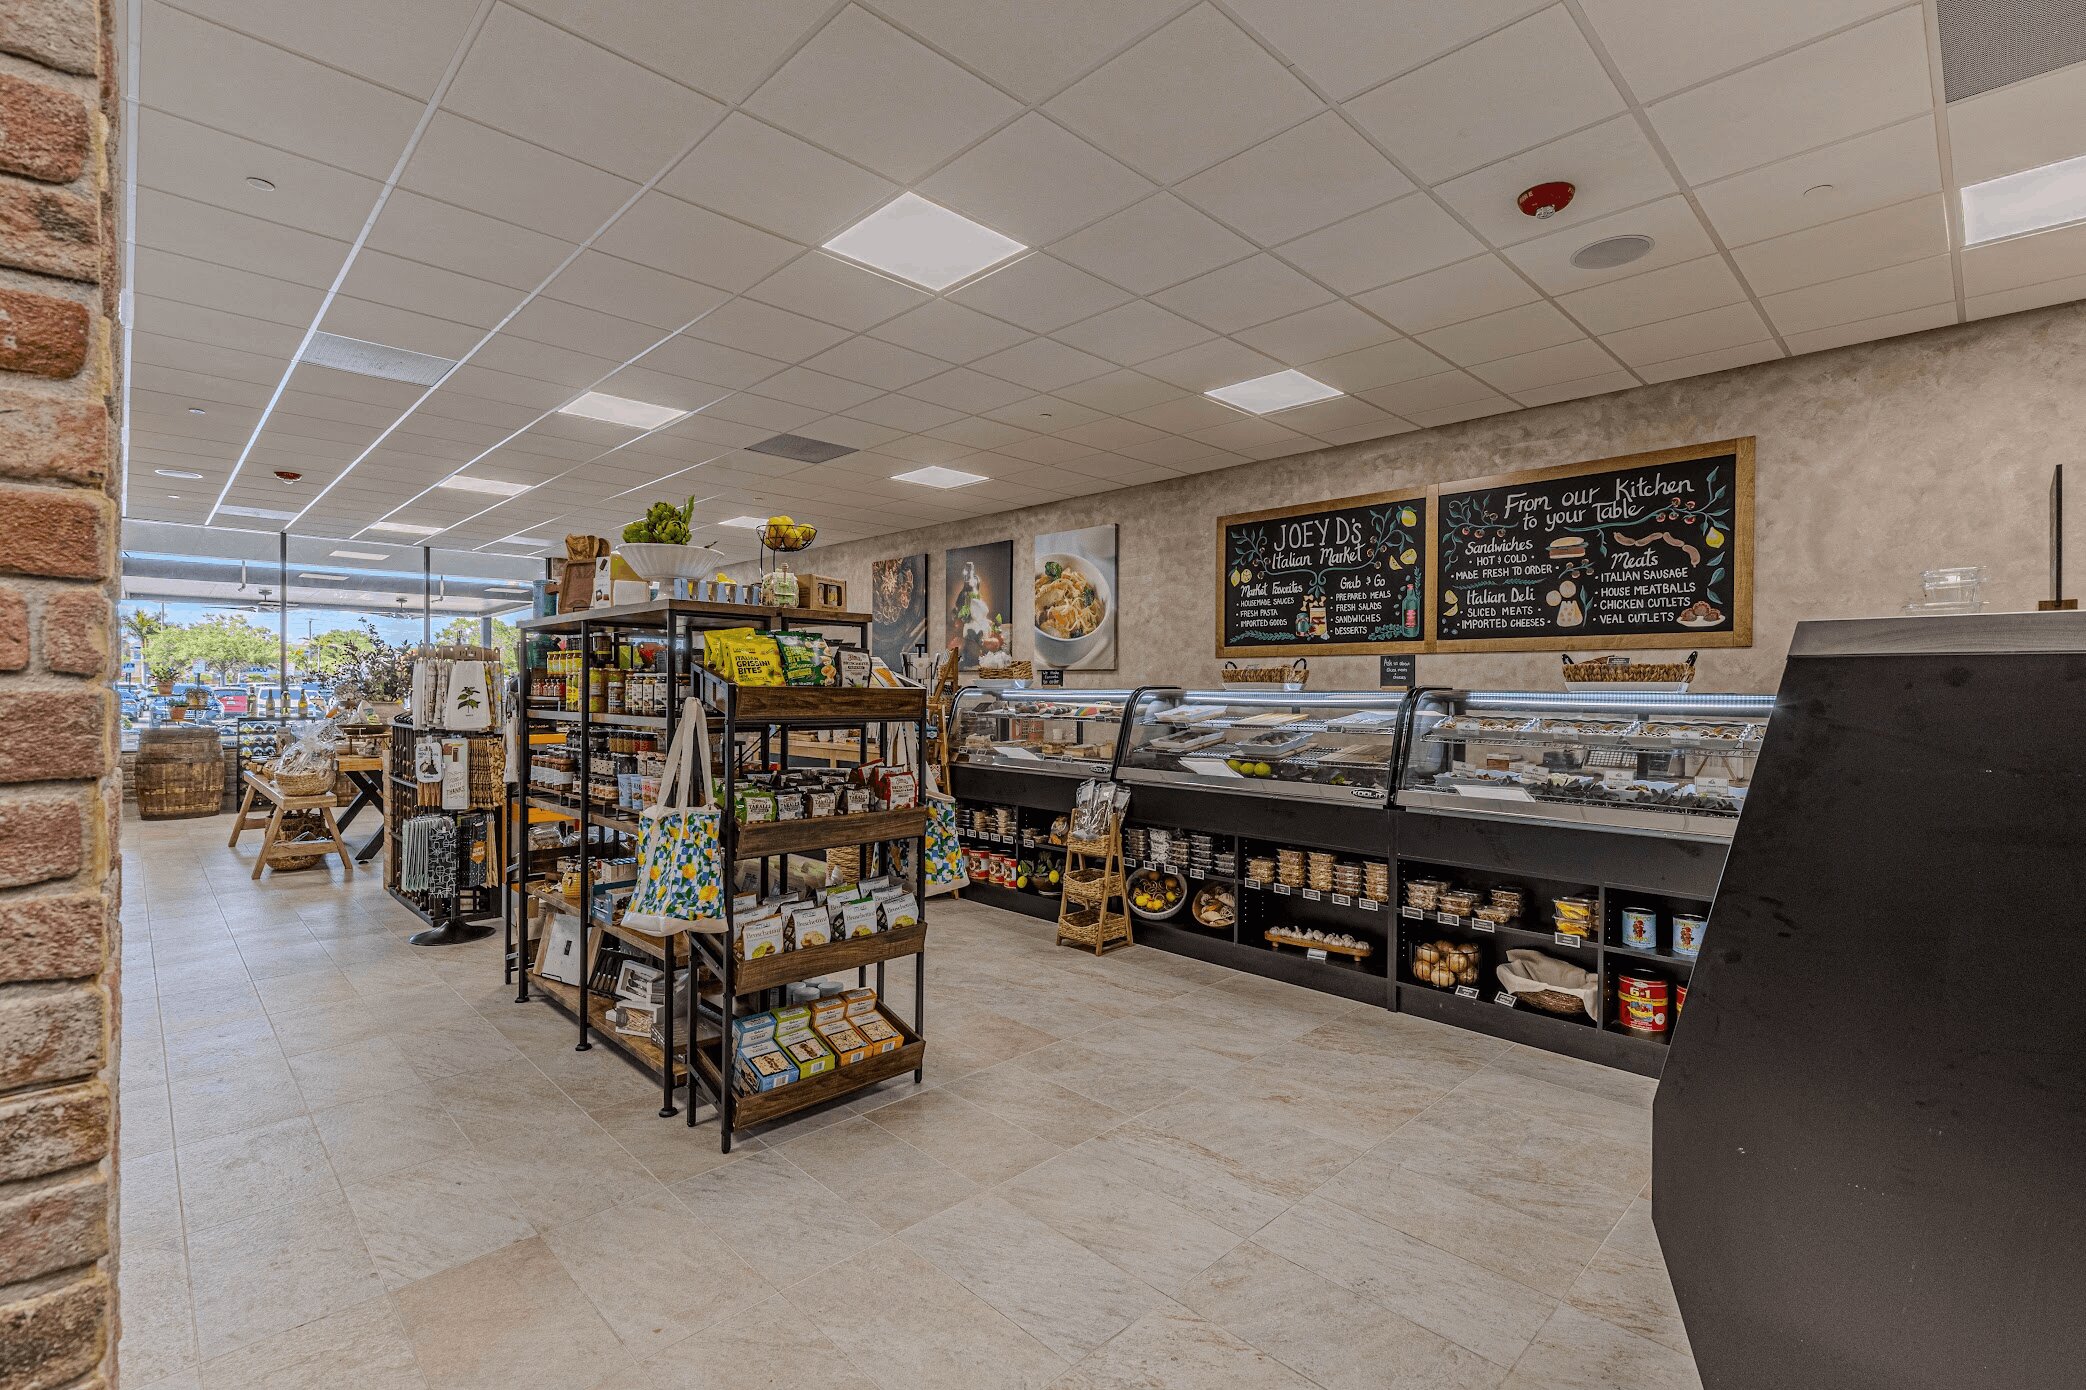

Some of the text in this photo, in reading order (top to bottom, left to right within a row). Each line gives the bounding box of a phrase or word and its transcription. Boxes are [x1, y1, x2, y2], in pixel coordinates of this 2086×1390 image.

[1504, 473, 1694, 519] From our Kitchen
[1523, 501, 1644, 531] to your Table
[1274, 518, 1329, 551] JOEY
[1465, 537, 1533, 555] Sandwiches
[1272, 543, 1366, 569] Italian Market
[1477, 556, 1496, 566] HOT
[1504, 554, 1527, 563] COLD
[1611, 548, 1658, 569] Meats
[1456, 565, 1552, 579] MADE FRESH TO ORDER
[1601, 568, 1688, 581] ITALIAN SAUSAGE
[1272, 581, 1303, 595] Favorites
[1340, 576, 1361, 589] Grab
[1374, 574, 1385, 586] Go
[1466, 587, 1535, 605] Italian Deli
[1601, 583, 1695, 596] HOUSE MEATBALLS
[1241, 597, 1294, 608] HOUSEMADE SAUCES
[1336, 604, 1356, 612] FRESH
[1600, 596, 1690, 609] CHICKEN CUTLETS
[1467, 606, 1533, 616] SLICED MEATS
[1335, 614, 1381, 623] SANDWICHES
[1462, 617, 1545, 629] IMPORTED CHEESES
[1600, 612, 1674, 624] VEAL CUTLETS
[1335, 627, 1367, 635] DESSERTS
